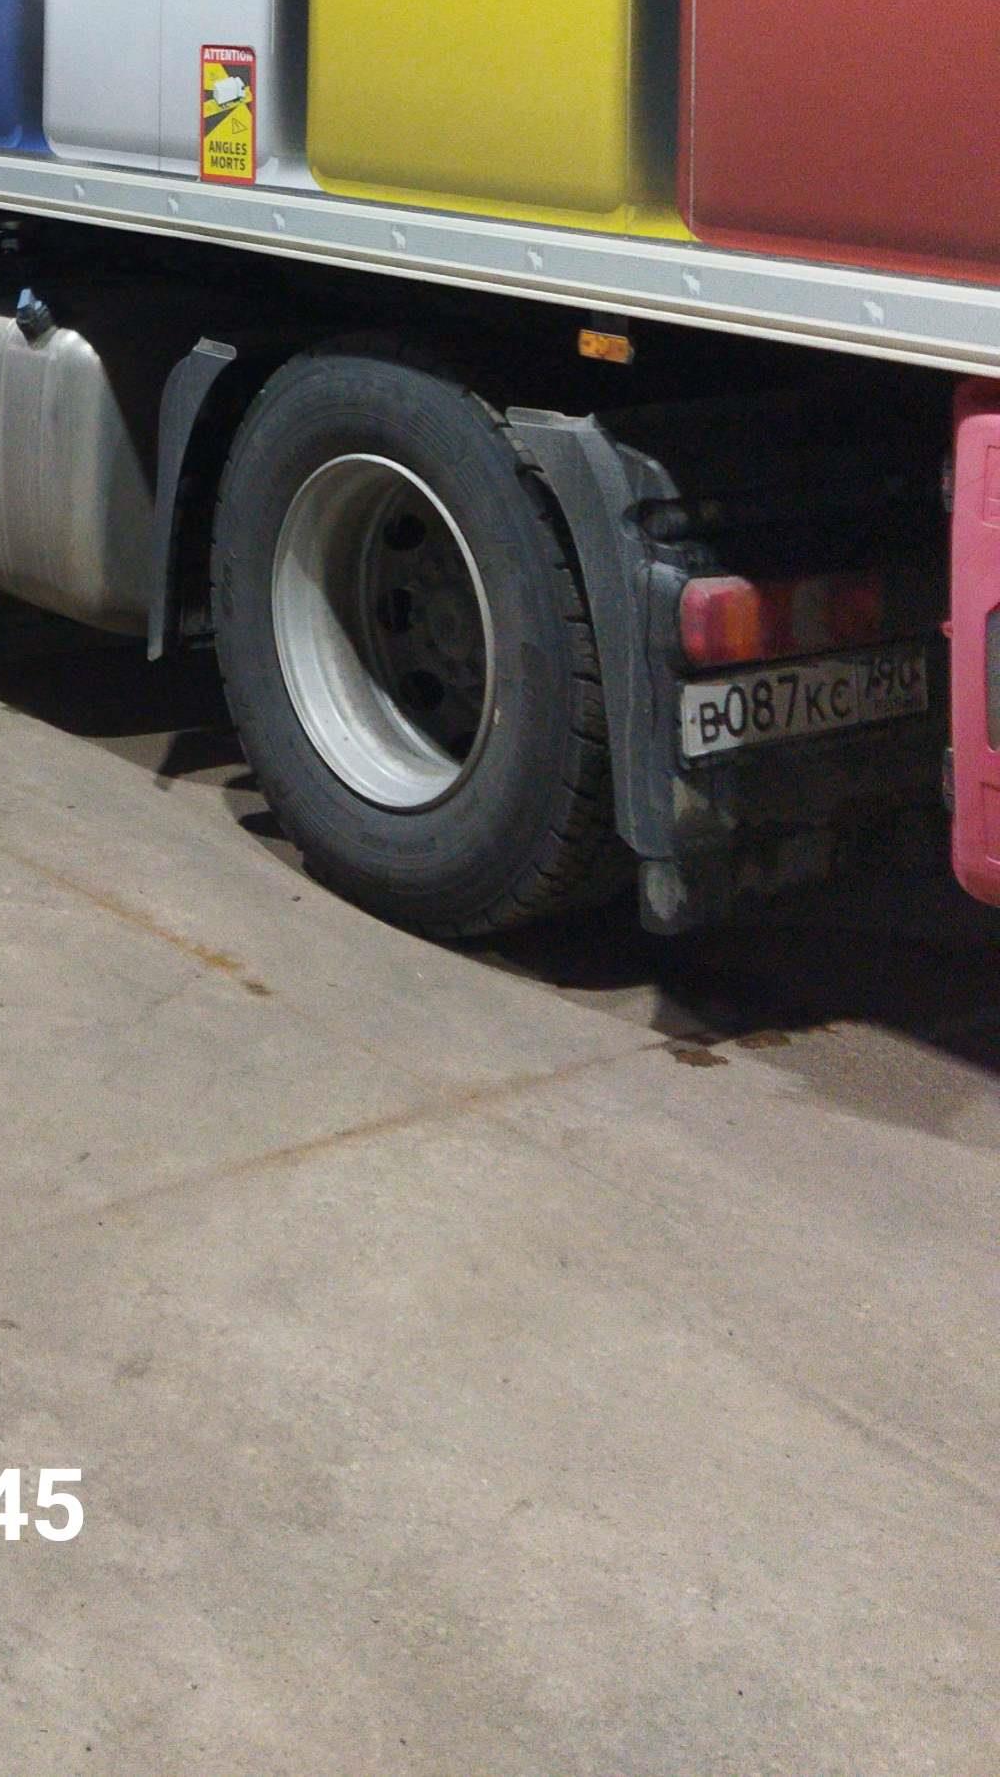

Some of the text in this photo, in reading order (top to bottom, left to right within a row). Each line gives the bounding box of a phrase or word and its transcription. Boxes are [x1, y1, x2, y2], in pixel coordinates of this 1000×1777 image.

[203, 47, 254, 63] ATTENTION
[209, 140, 248, 157] ANGLES
[210, 155, 246, 171] MORTS
